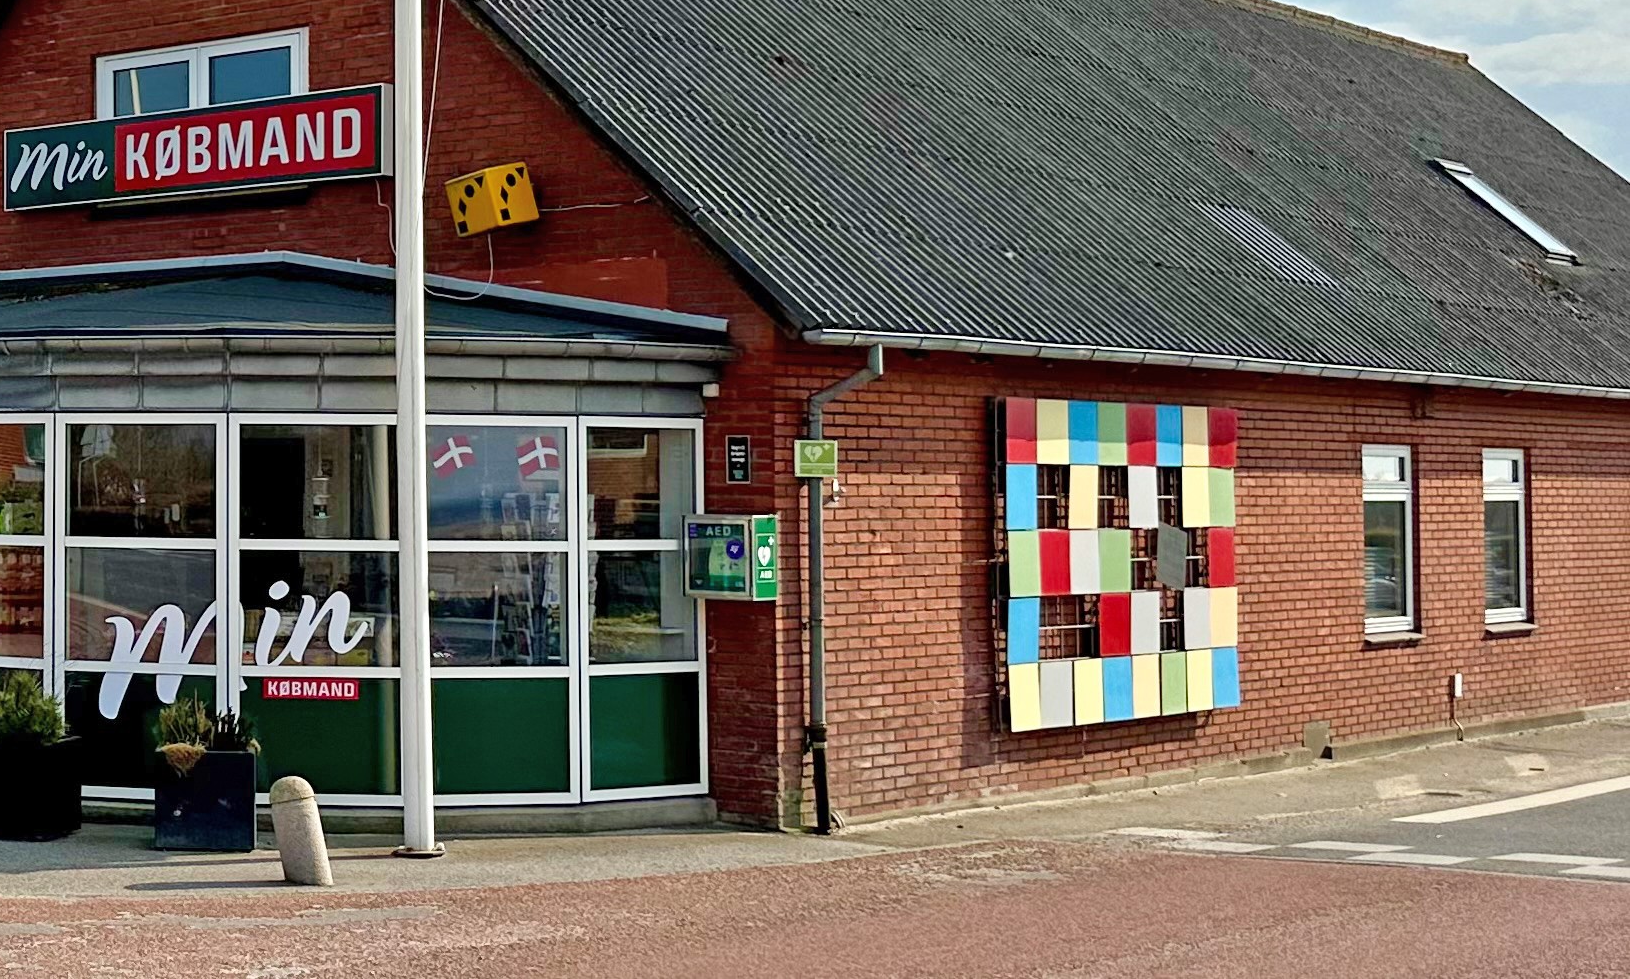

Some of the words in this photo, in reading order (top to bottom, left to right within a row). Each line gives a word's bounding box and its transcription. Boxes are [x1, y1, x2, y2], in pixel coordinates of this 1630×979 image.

[126, 107, 361, 181] KØBMAND
[706, 526, 731, 537] AED
[268, 679, 355, 698] KØBMAND
